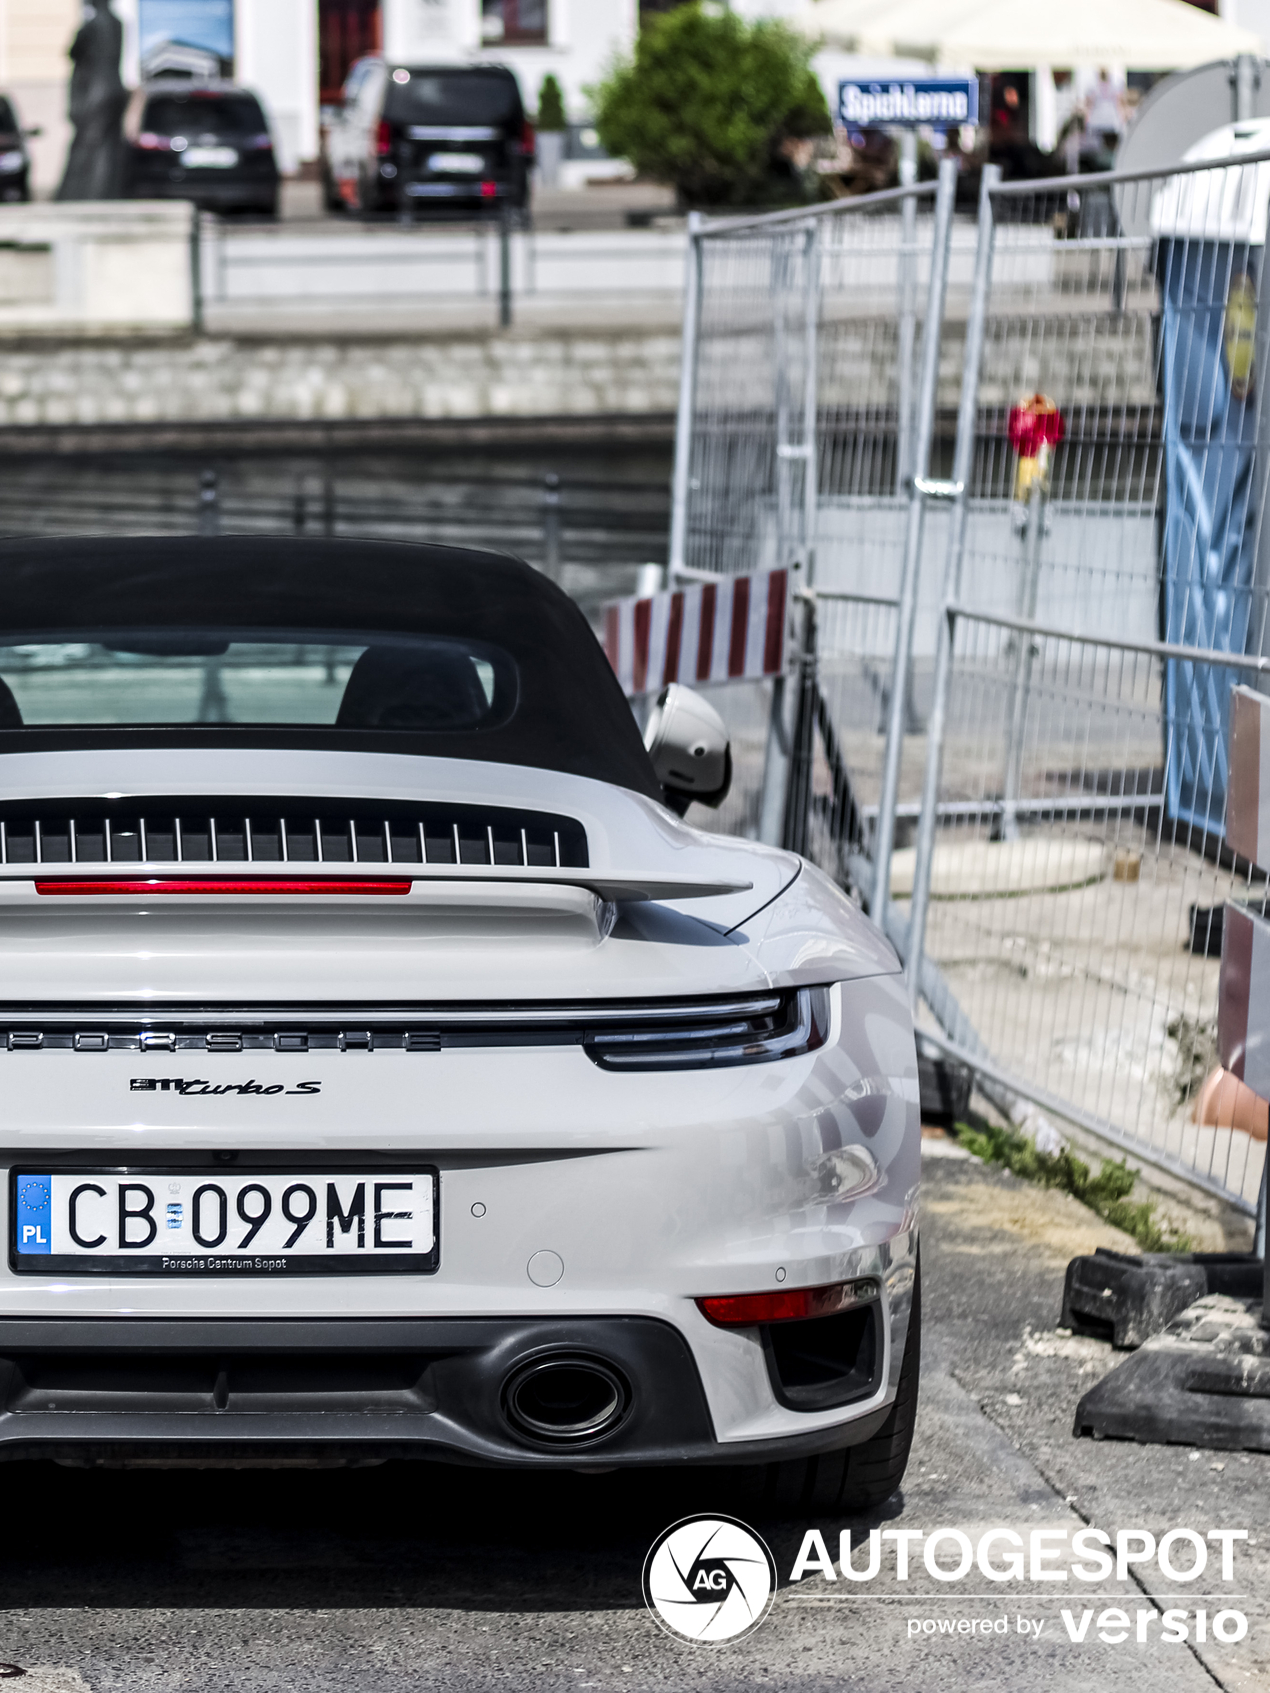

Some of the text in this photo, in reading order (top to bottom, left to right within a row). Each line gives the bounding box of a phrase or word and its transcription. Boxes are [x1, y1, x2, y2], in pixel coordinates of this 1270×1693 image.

[7, 1031, 441, 1052] PORSCHE
[284, 1081, 322, 1095] S
[68, 1182, 413, 1249] CB 099ME
[22, 1225, 47, 1244] PL
[162, 1257, 287, 1271] Porsche Centrum Sopot
